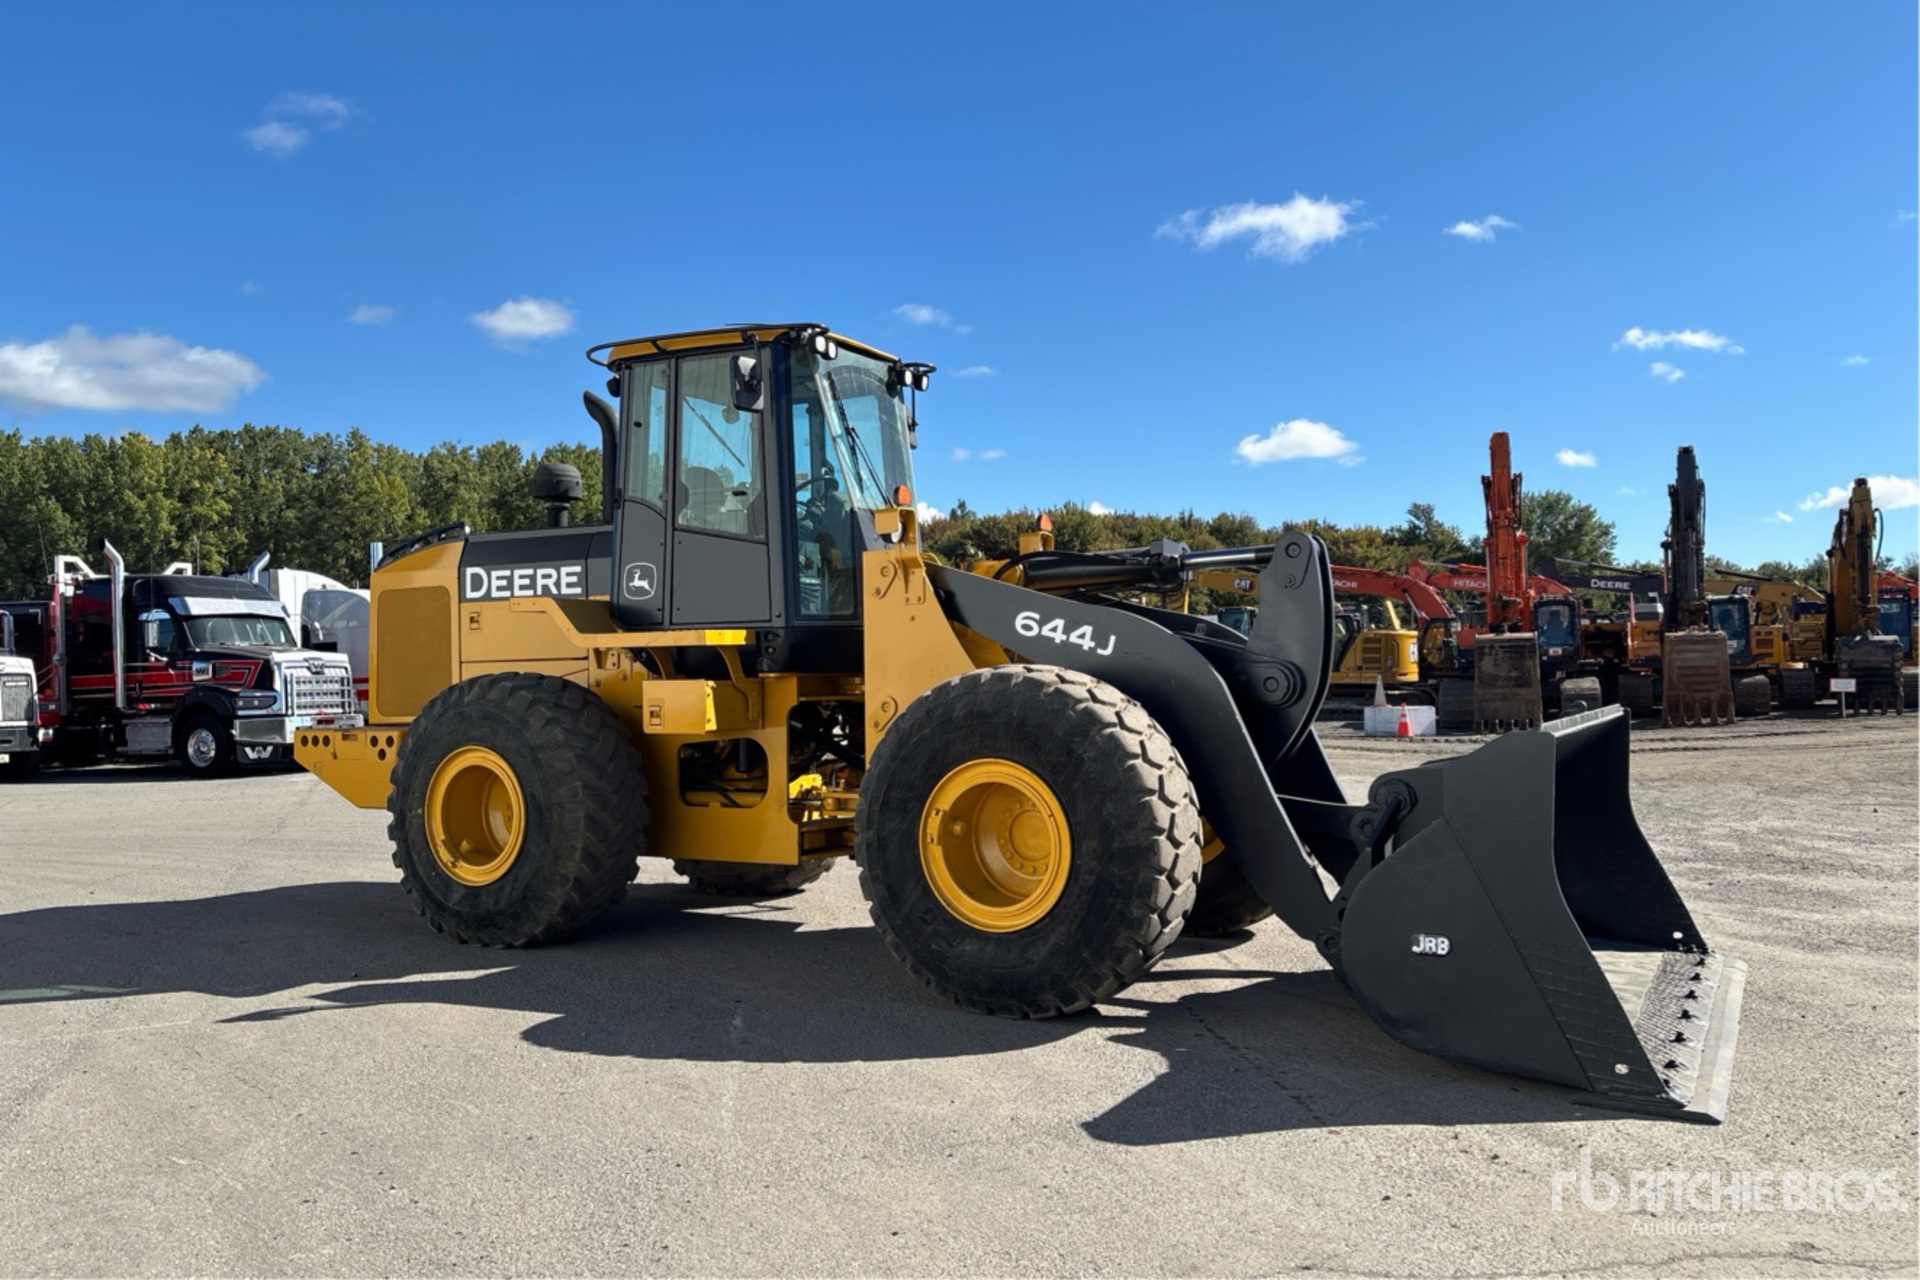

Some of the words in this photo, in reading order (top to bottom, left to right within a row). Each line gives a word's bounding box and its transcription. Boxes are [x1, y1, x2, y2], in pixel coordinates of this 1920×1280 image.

[465, 565, 583, 599] DEERE
[1234, 578, 1251, 590] CAT
[1331, 579, 1358, 589] ACHI
[1453, 579, 1488, 589] HITACH
[1590, 578, 1631, 590] DEERE
[1411, 933, 1451, 955] JRB
